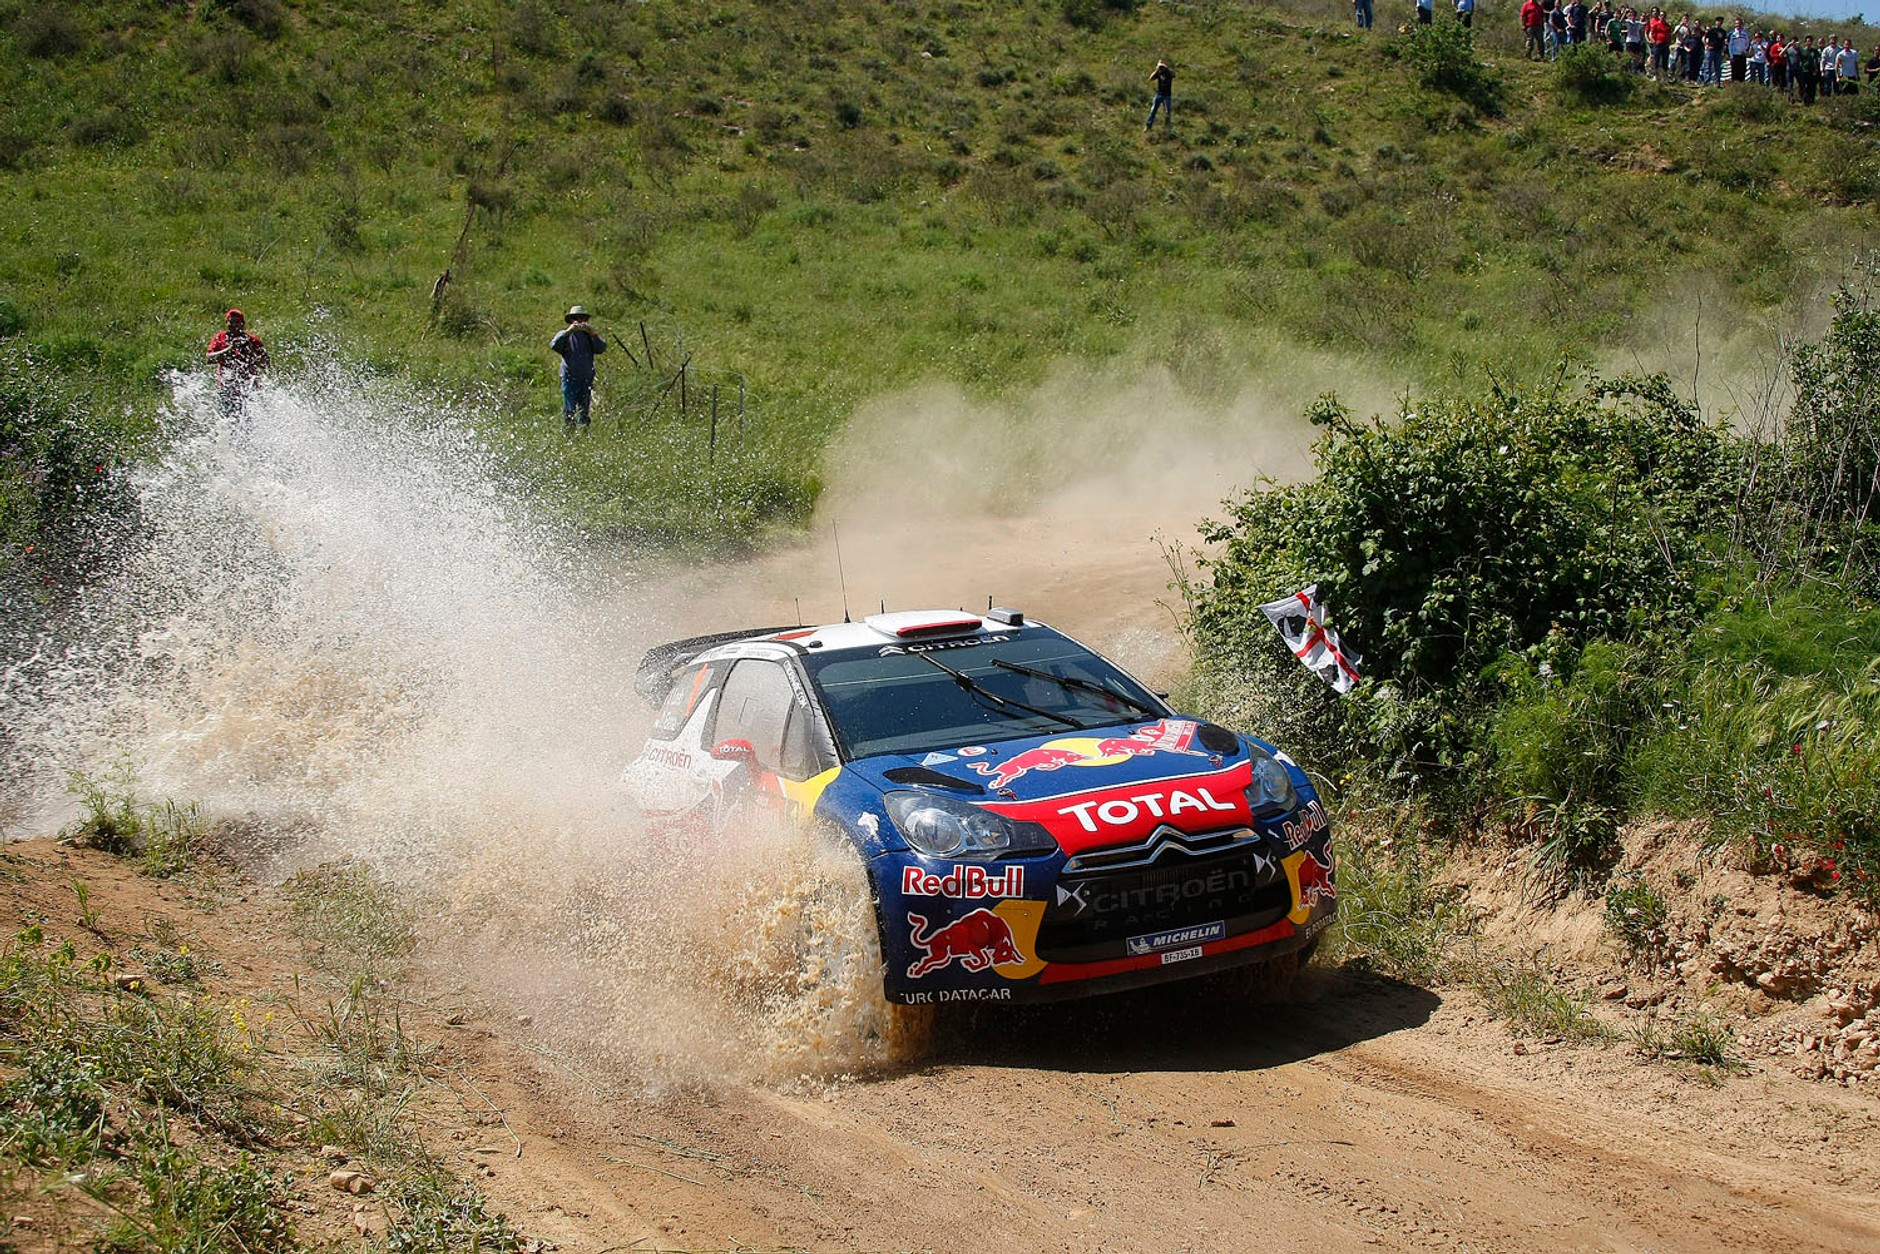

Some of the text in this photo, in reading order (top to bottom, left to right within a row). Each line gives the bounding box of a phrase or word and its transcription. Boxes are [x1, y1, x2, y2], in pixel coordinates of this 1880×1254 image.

[718, 745, 751, 753] TOTAL
[1058, 787, 1236, 833] TOTAL
[902, 865, 1025, 899] Red Bull
[1152, 924, 1222, 947] MICHELIN
